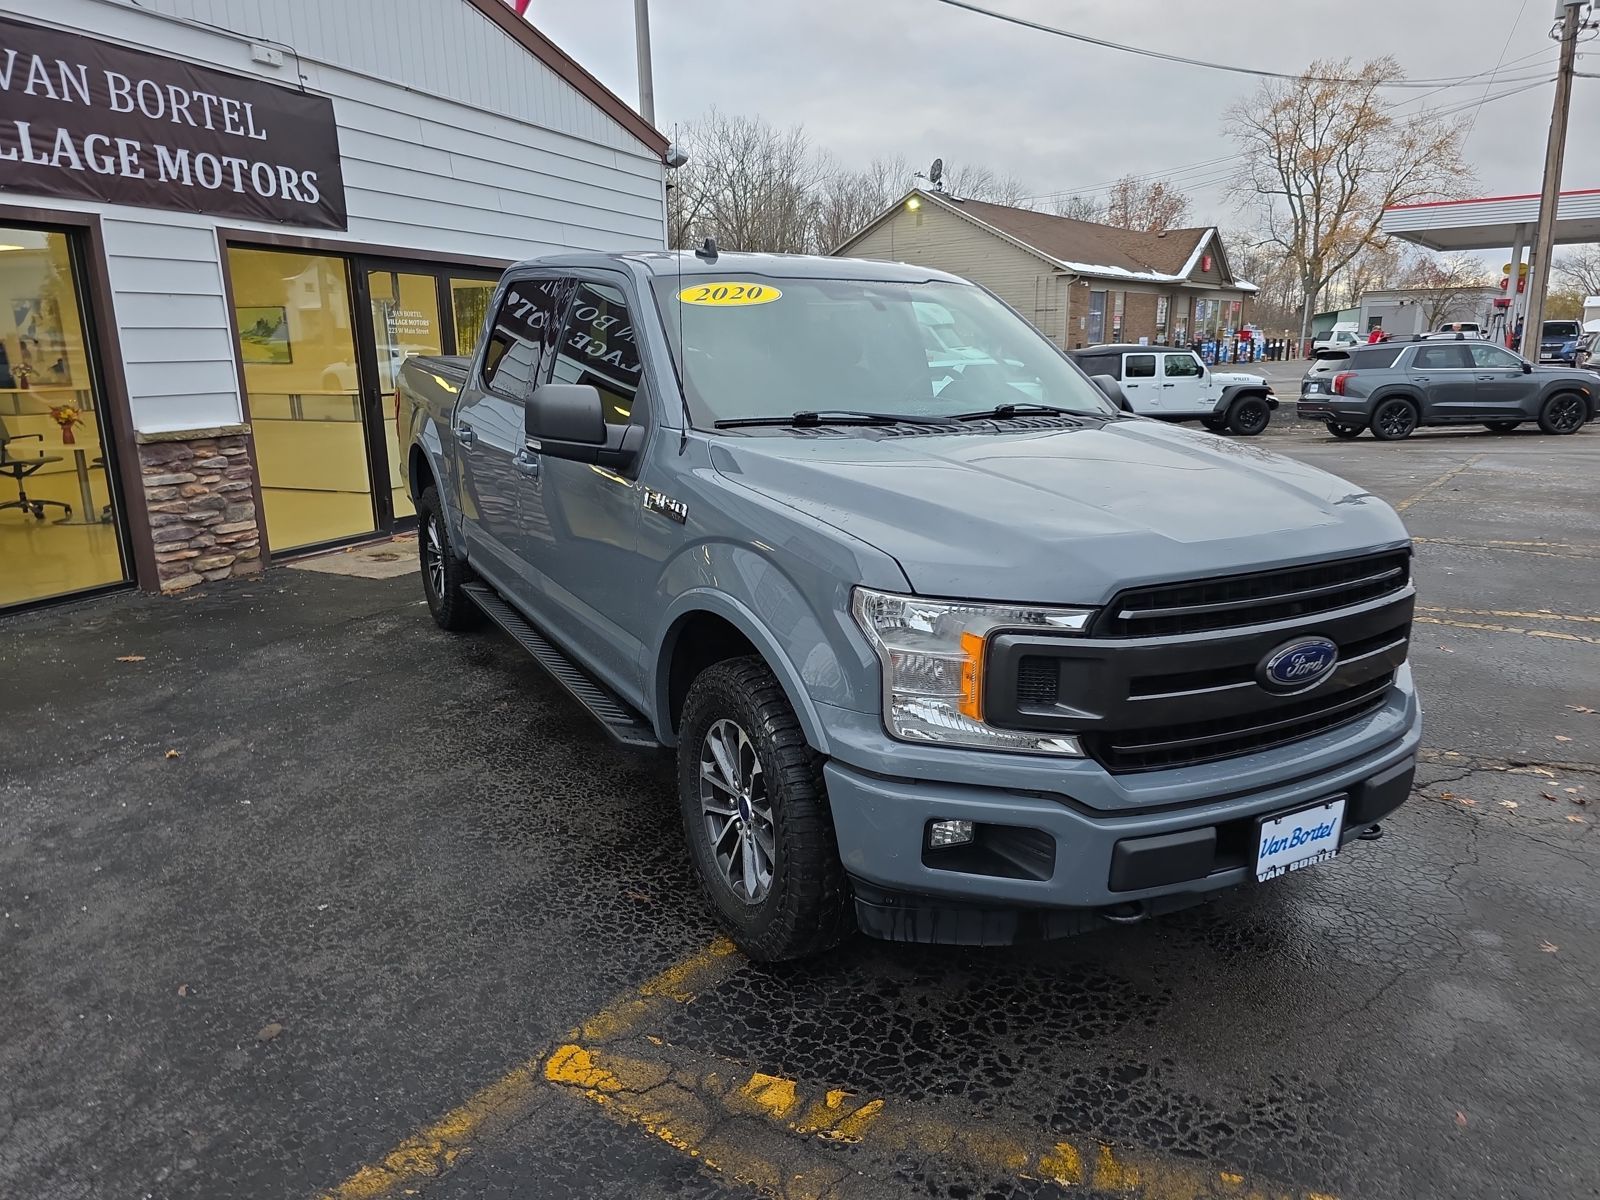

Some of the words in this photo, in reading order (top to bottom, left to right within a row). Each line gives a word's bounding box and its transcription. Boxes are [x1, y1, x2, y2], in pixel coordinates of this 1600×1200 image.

[103, 70, 267, 141] BORTEL
[153, 144, 321, 204] MOTORS
[694, 286, 763, 301] 2020
[1286, 651, 1325, 677] Ford
[1257, 866, 1286, 883] VAN
[1290, 850, 1338, 872] BORTEL
